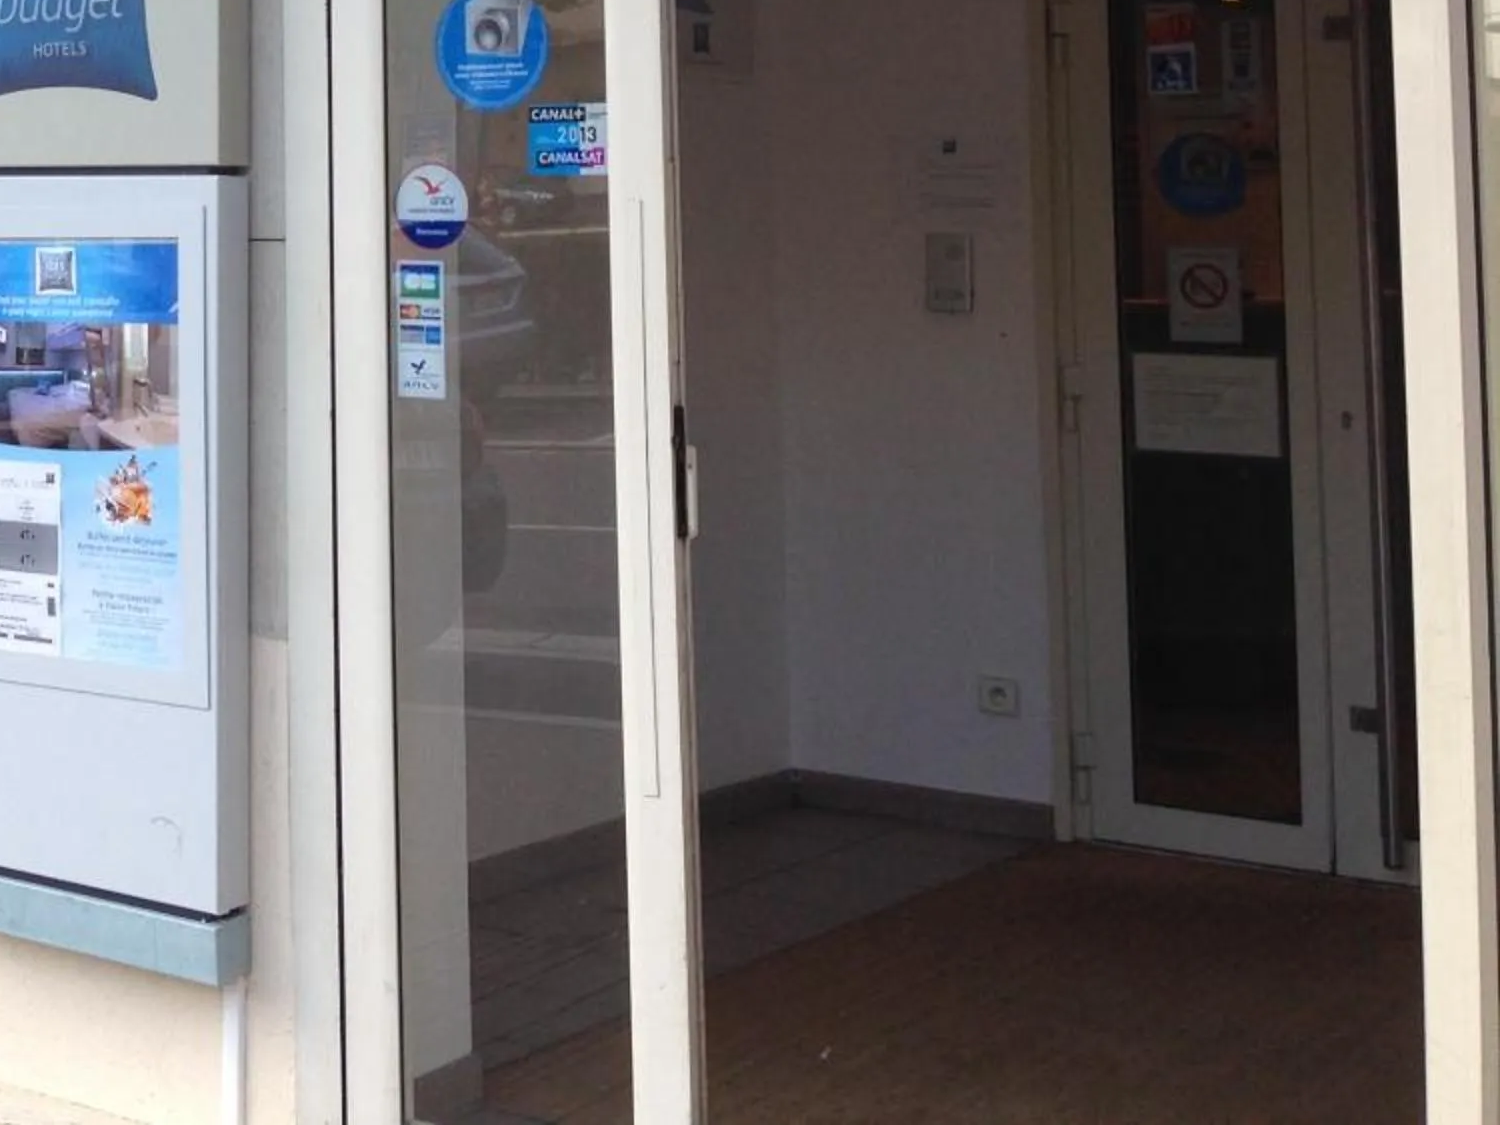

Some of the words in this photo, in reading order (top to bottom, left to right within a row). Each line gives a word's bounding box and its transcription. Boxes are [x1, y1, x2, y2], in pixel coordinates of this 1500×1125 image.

[32, 39, 88, 60] HOTELS
[531, 107, 585, 122] CANAL+
[556, 125, 597, 145] 2013
[538, 150, 603, 166] CANALSAT
